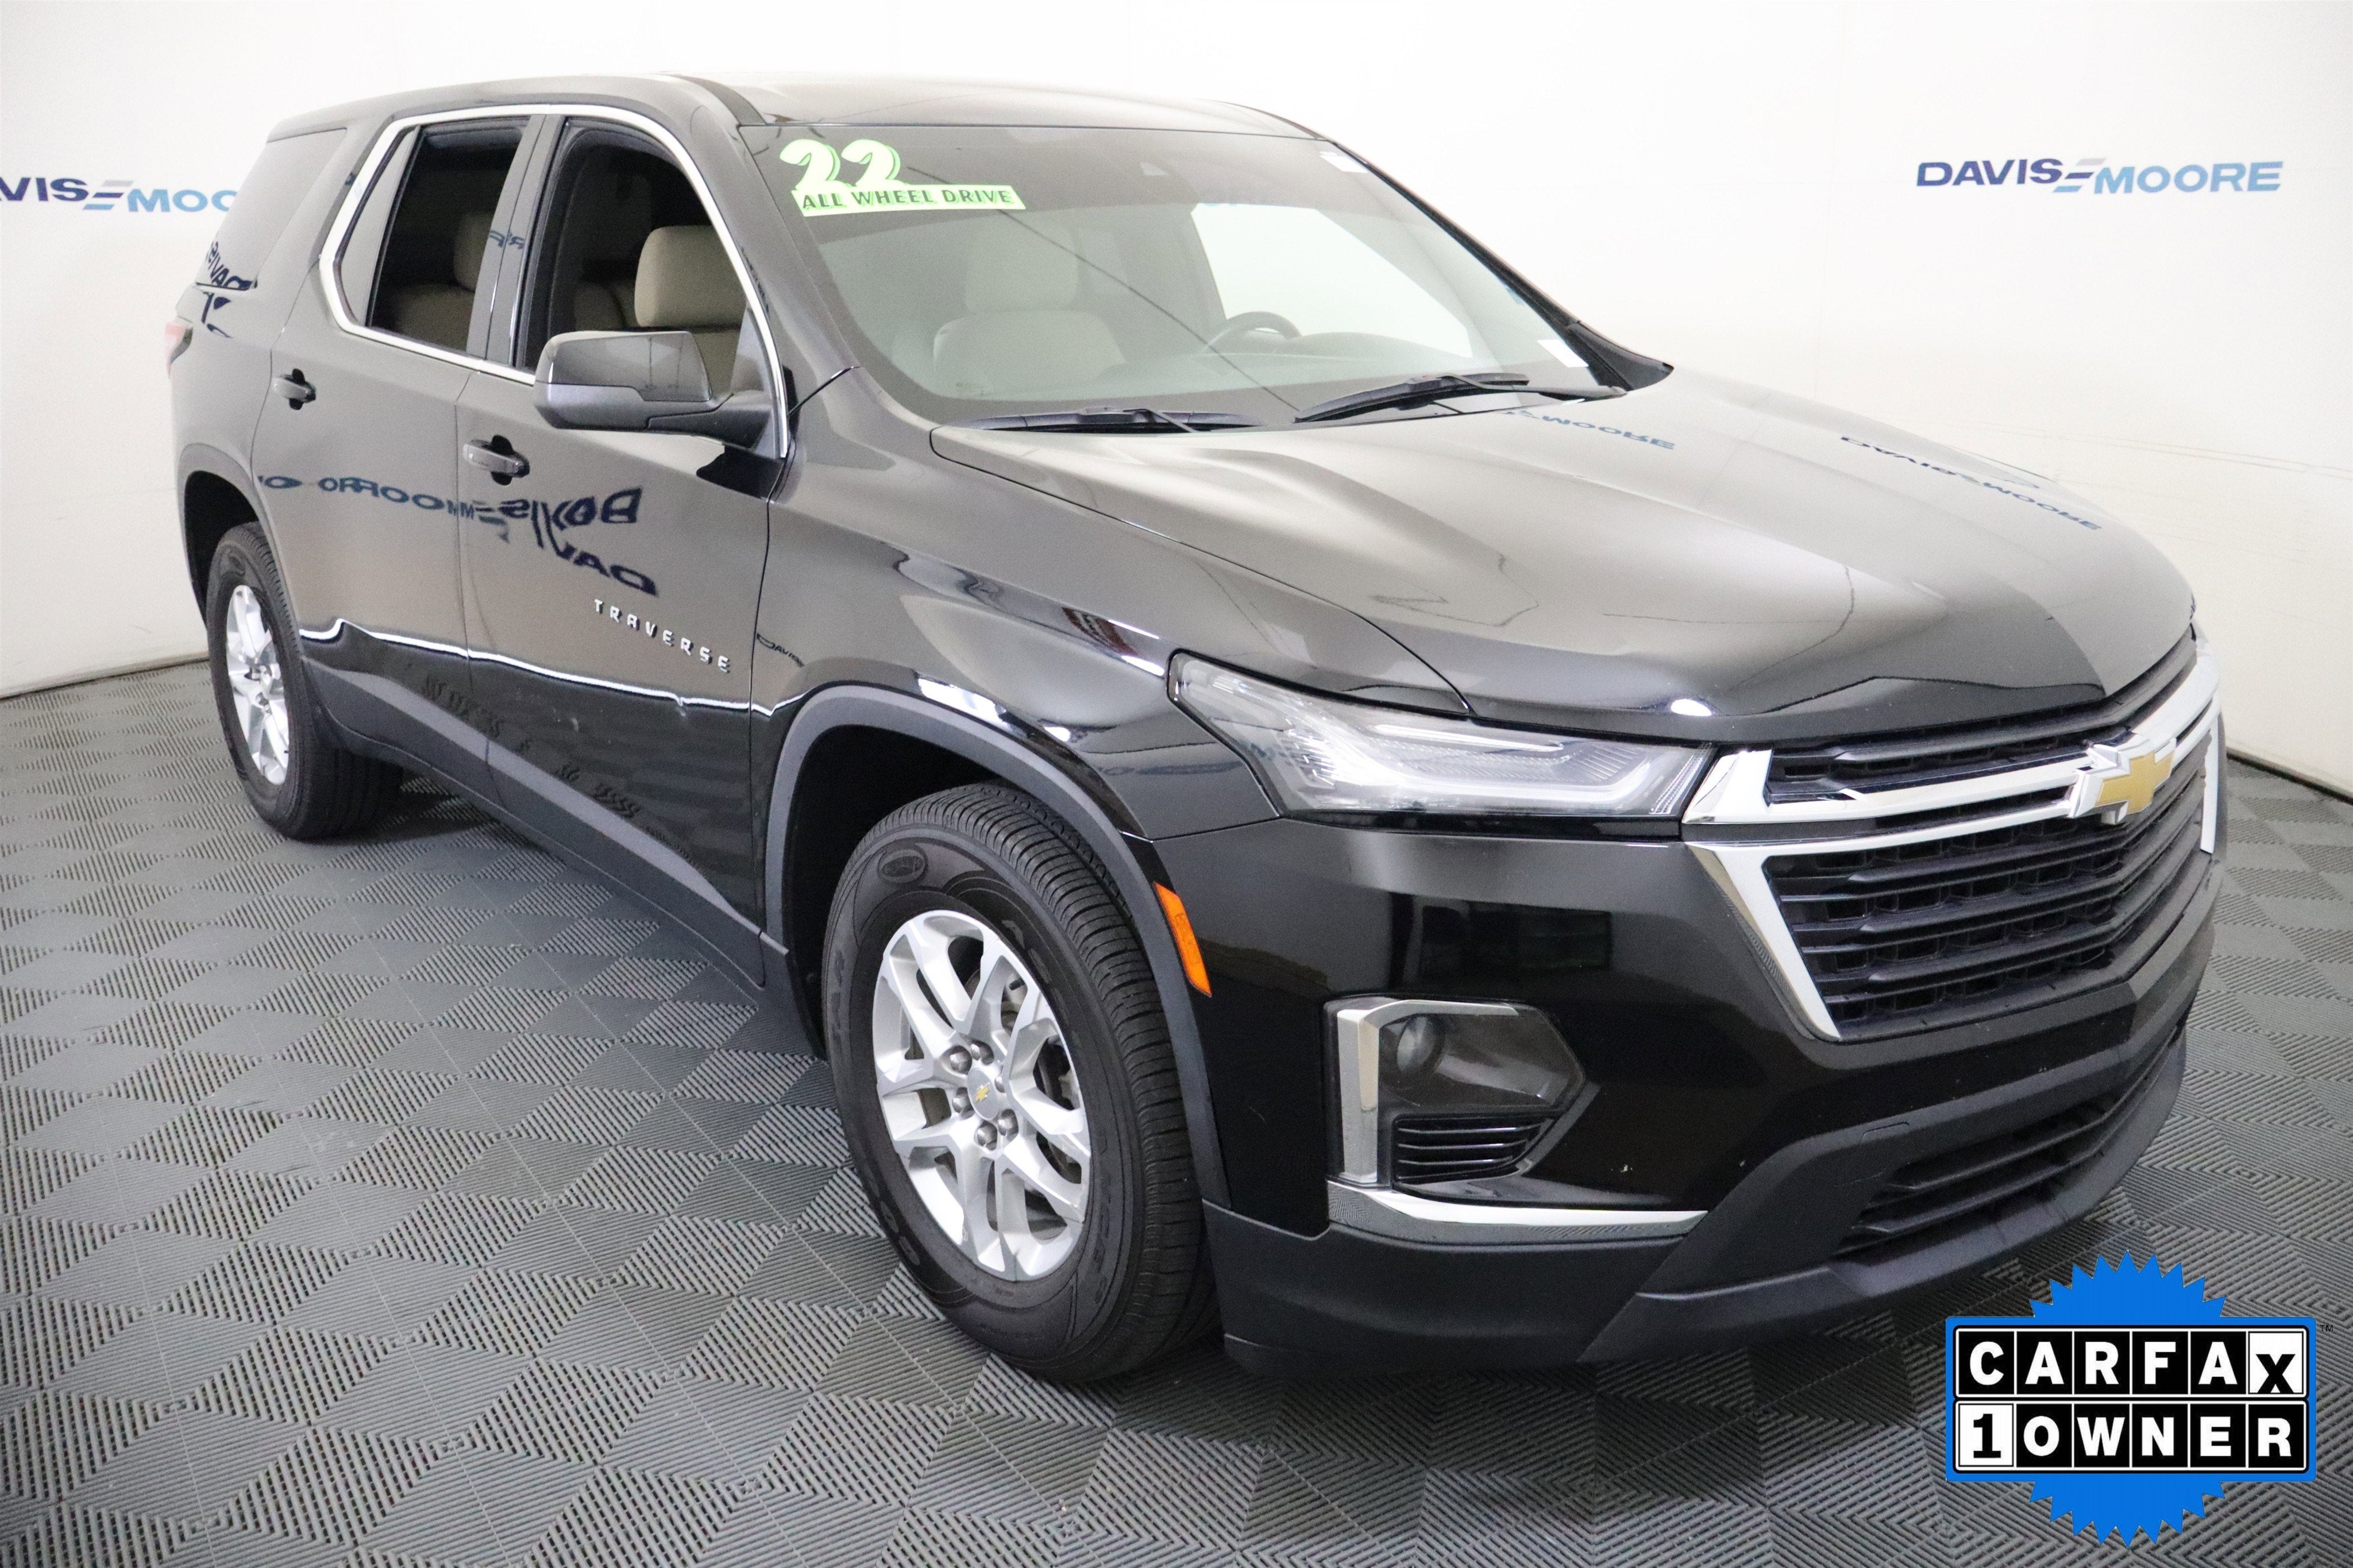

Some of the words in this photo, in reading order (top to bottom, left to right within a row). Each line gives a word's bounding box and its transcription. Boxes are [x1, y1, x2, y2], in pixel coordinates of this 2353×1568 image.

[779, 138, 901, 190] 22
[1916, 159, 2063, 187] DAVIS
[2094, 161, 2283, 194] MOORE
[0, 177, 89, 201] VIS
[803, 193, 844, 209] ALL
[851, 190, 935, 206] WHEEL
[941, 190, 1013, 203] DRIVE
[594, 598, 730, 673] TRAVERSE
